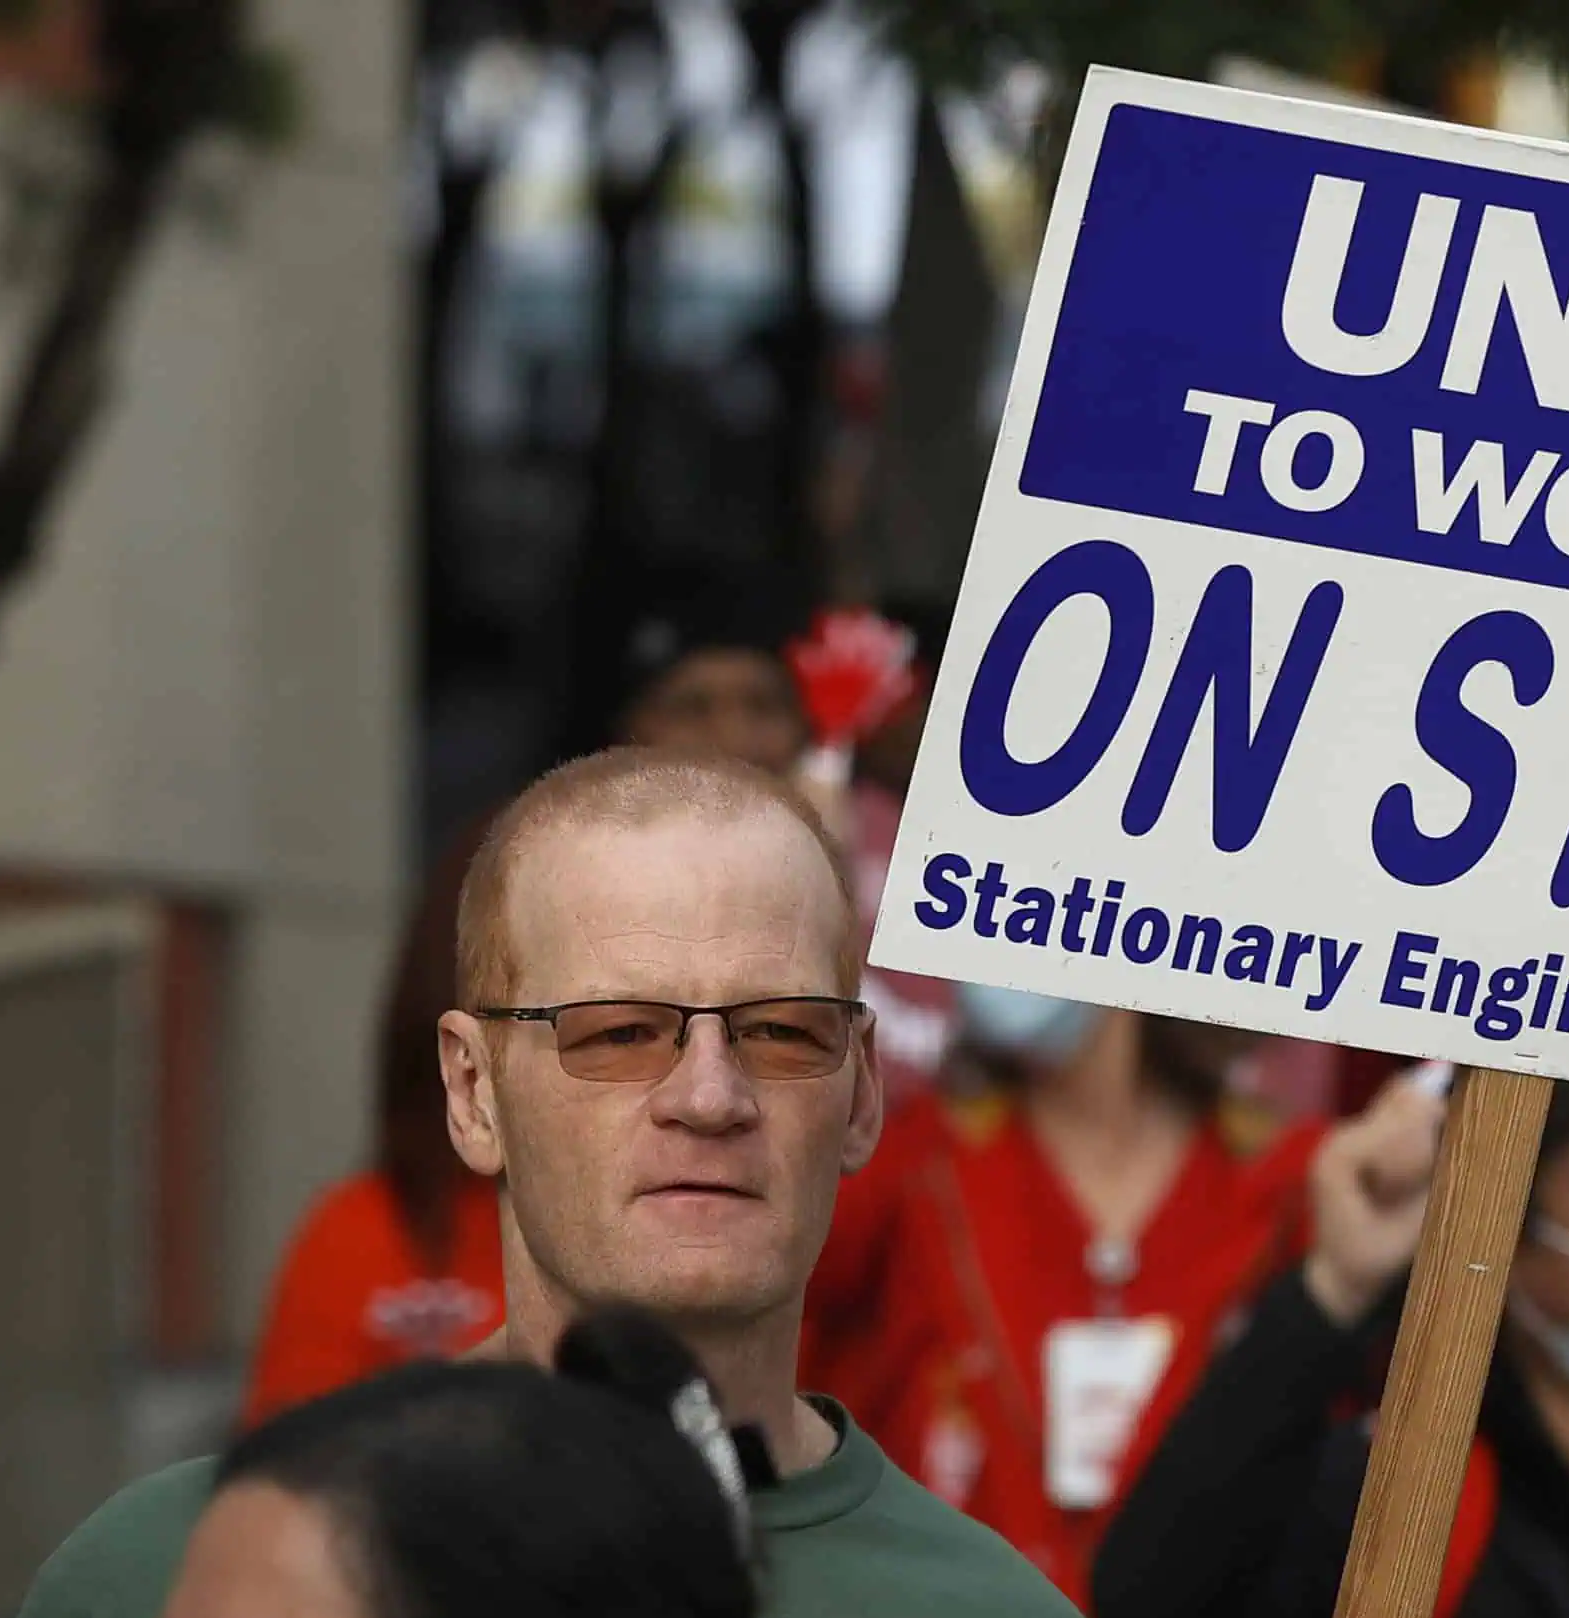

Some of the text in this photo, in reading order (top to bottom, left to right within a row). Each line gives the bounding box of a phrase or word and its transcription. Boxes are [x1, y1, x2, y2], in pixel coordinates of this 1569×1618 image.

[1184, 390, 1364, 511] TO
[960, 540, 1343, 852] ON
[915, 853, 1362, 1011] Stationary
